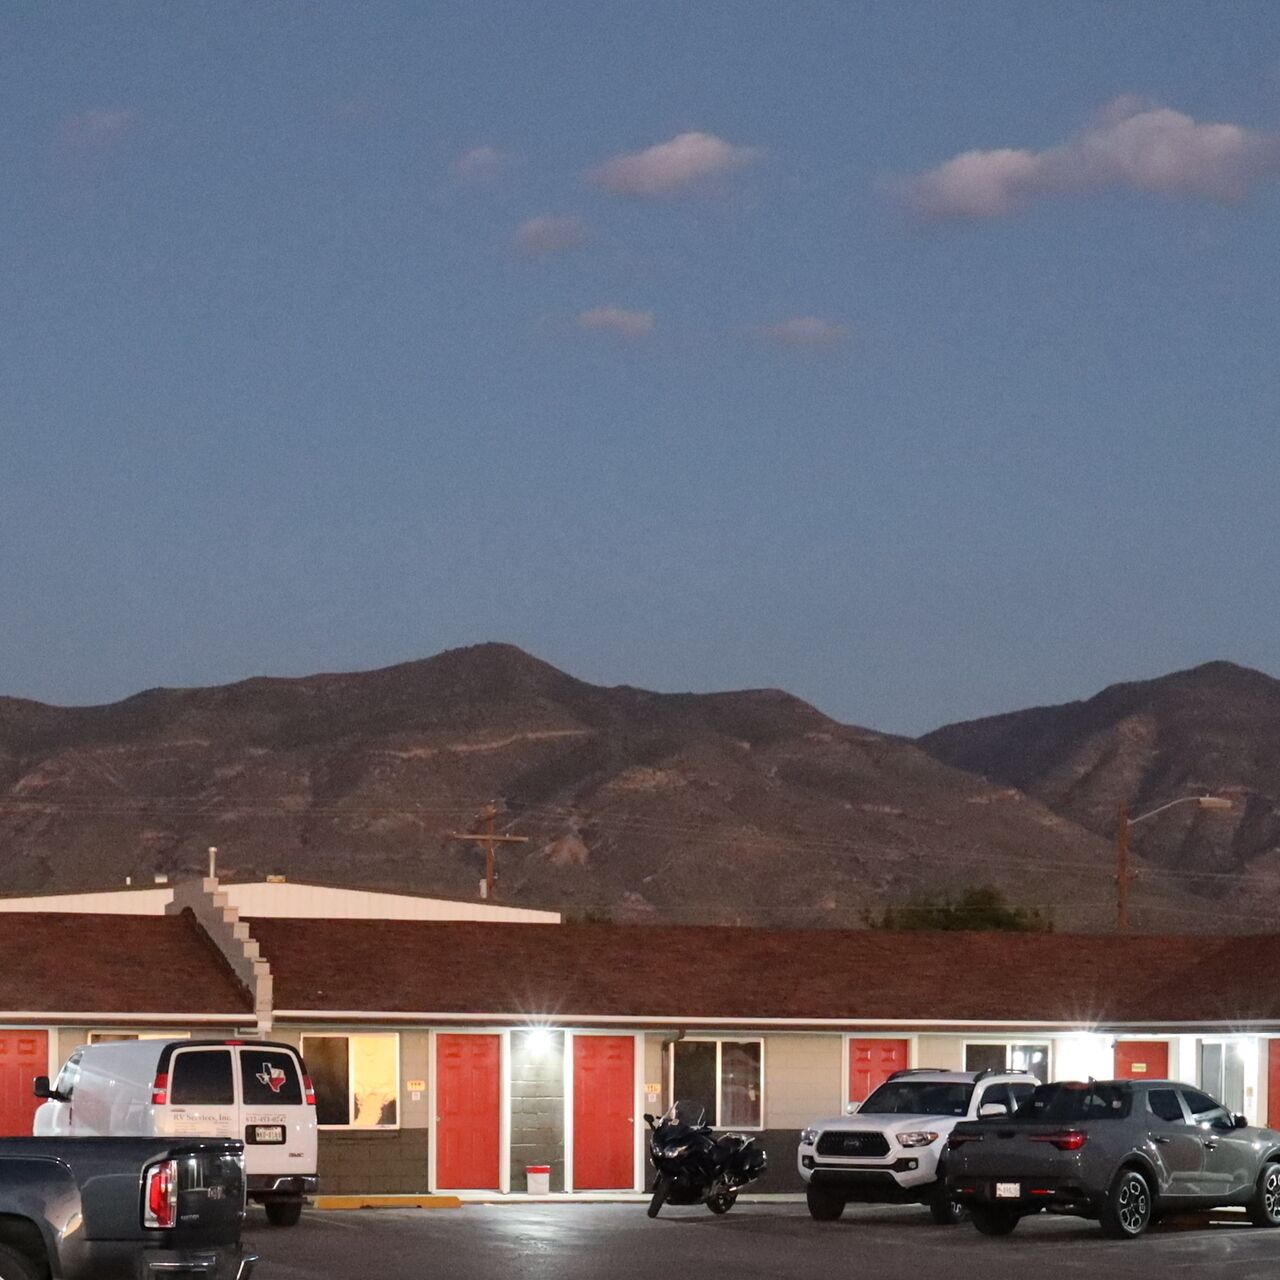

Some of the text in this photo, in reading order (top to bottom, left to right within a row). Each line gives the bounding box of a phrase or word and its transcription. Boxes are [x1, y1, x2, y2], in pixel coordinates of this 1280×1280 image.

[173, 1112, 232, 1122] RV Services, Inc.
